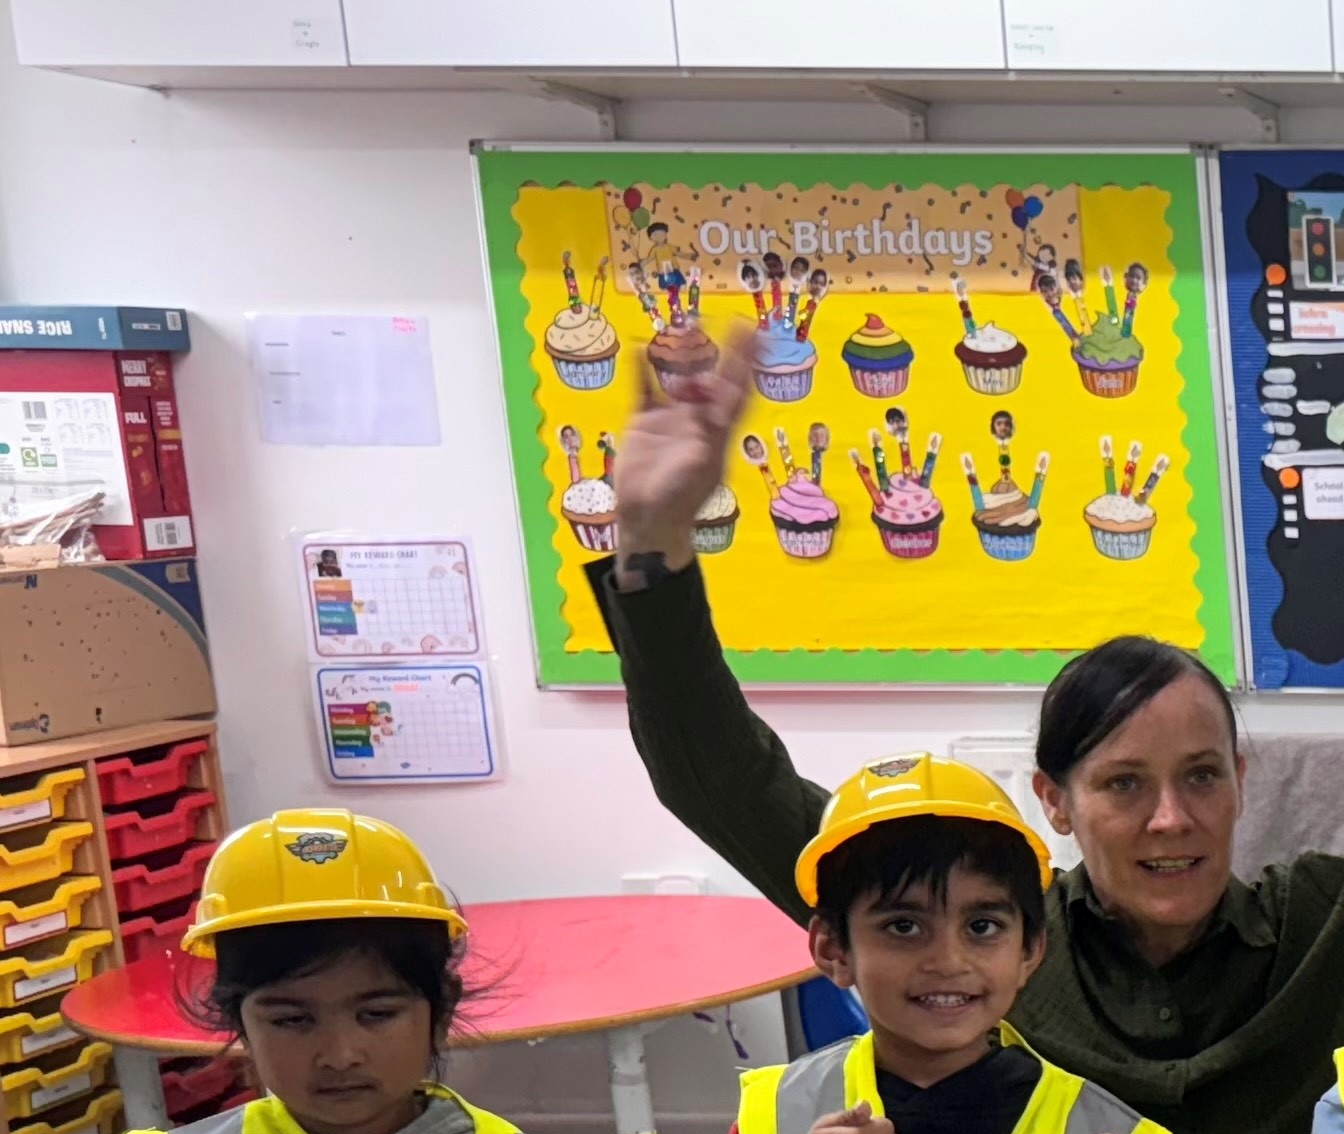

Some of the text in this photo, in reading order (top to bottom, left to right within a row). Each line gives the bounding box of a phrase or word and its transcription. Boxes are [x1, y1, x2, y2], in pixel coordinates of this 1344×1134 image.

[700, 217, 994, 267] Our Birthdays
[37, 318, 73, 336] RICE
[1313, 480, 1344, 491] School
